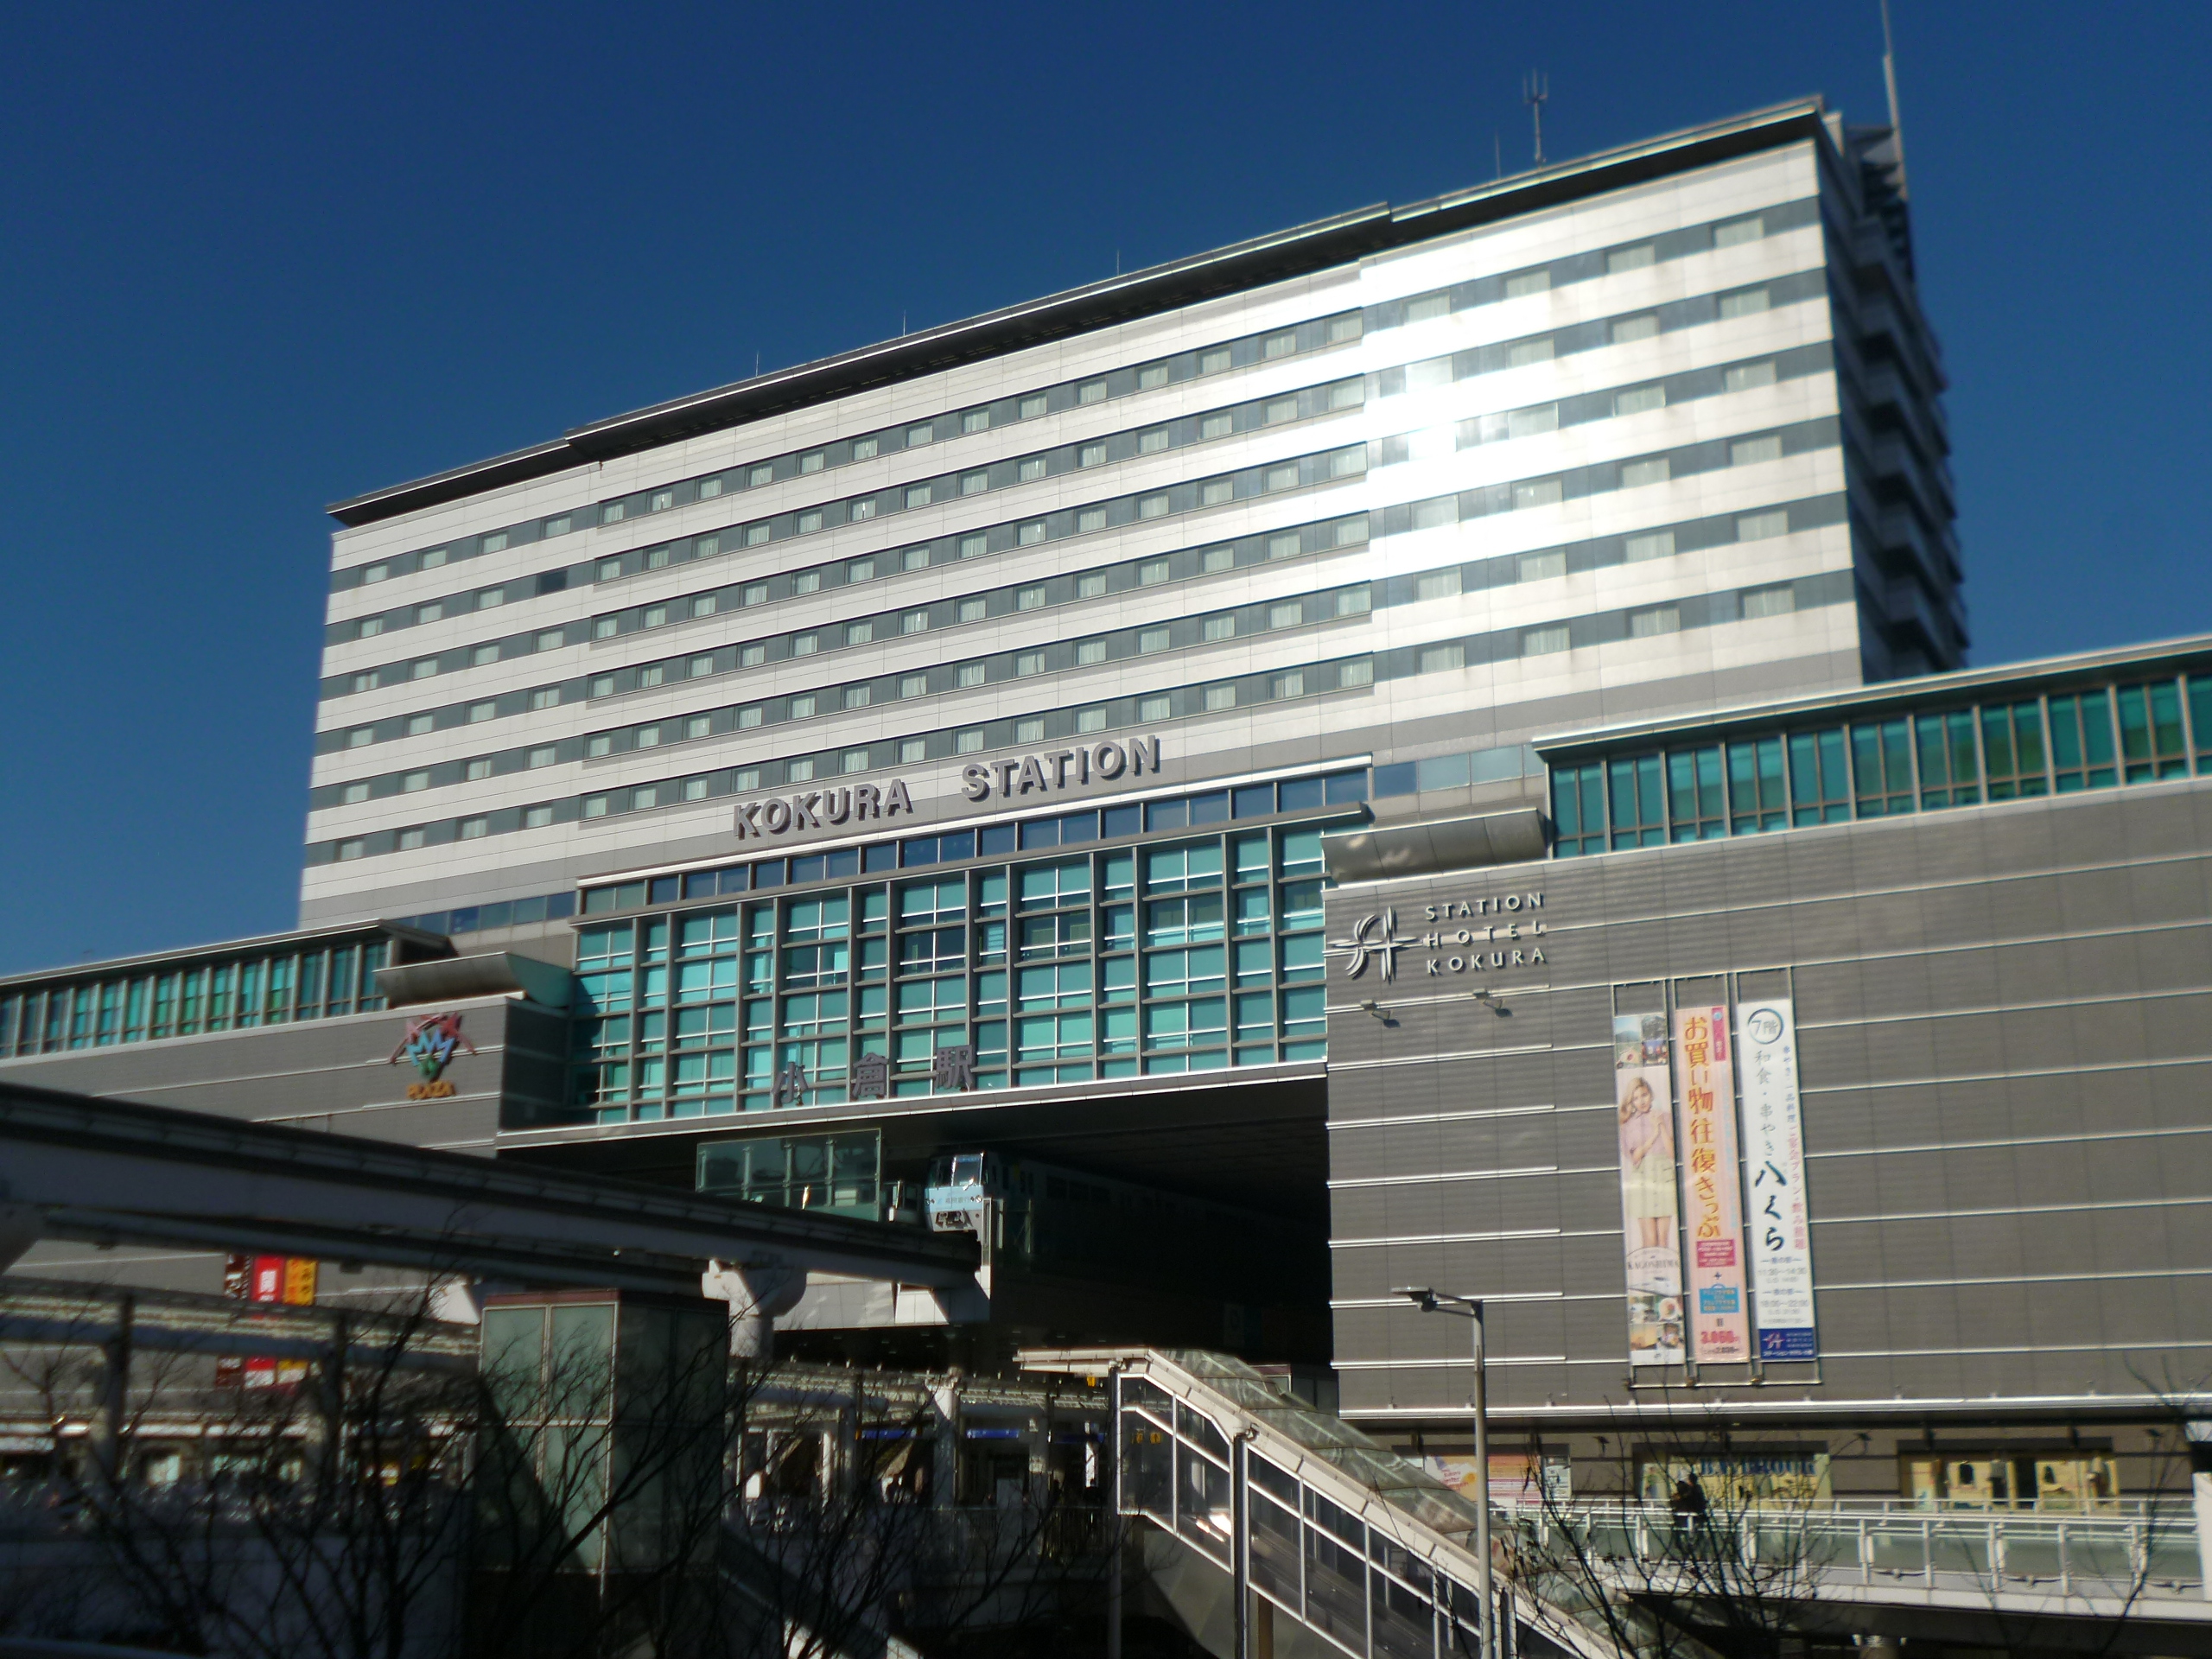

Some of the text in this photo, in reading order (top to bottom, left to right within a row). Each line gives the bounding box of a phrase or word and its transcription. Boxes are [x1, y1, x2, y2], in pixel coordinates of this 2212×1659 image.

[733, 734, 1160, 839] KOKURA STATION
[1426, 893, 1544, 920] STATION
[1427, 920, 1545, 948] HOTEL
[1427, 947, 1546, 975] KOKURA
[771, 1045, 974, 1104] 小倉駅
[1684, 1016, 1721, 1239] お買い物往復きっぷ
[1755, 1160, 1789, 1251] 八くら
